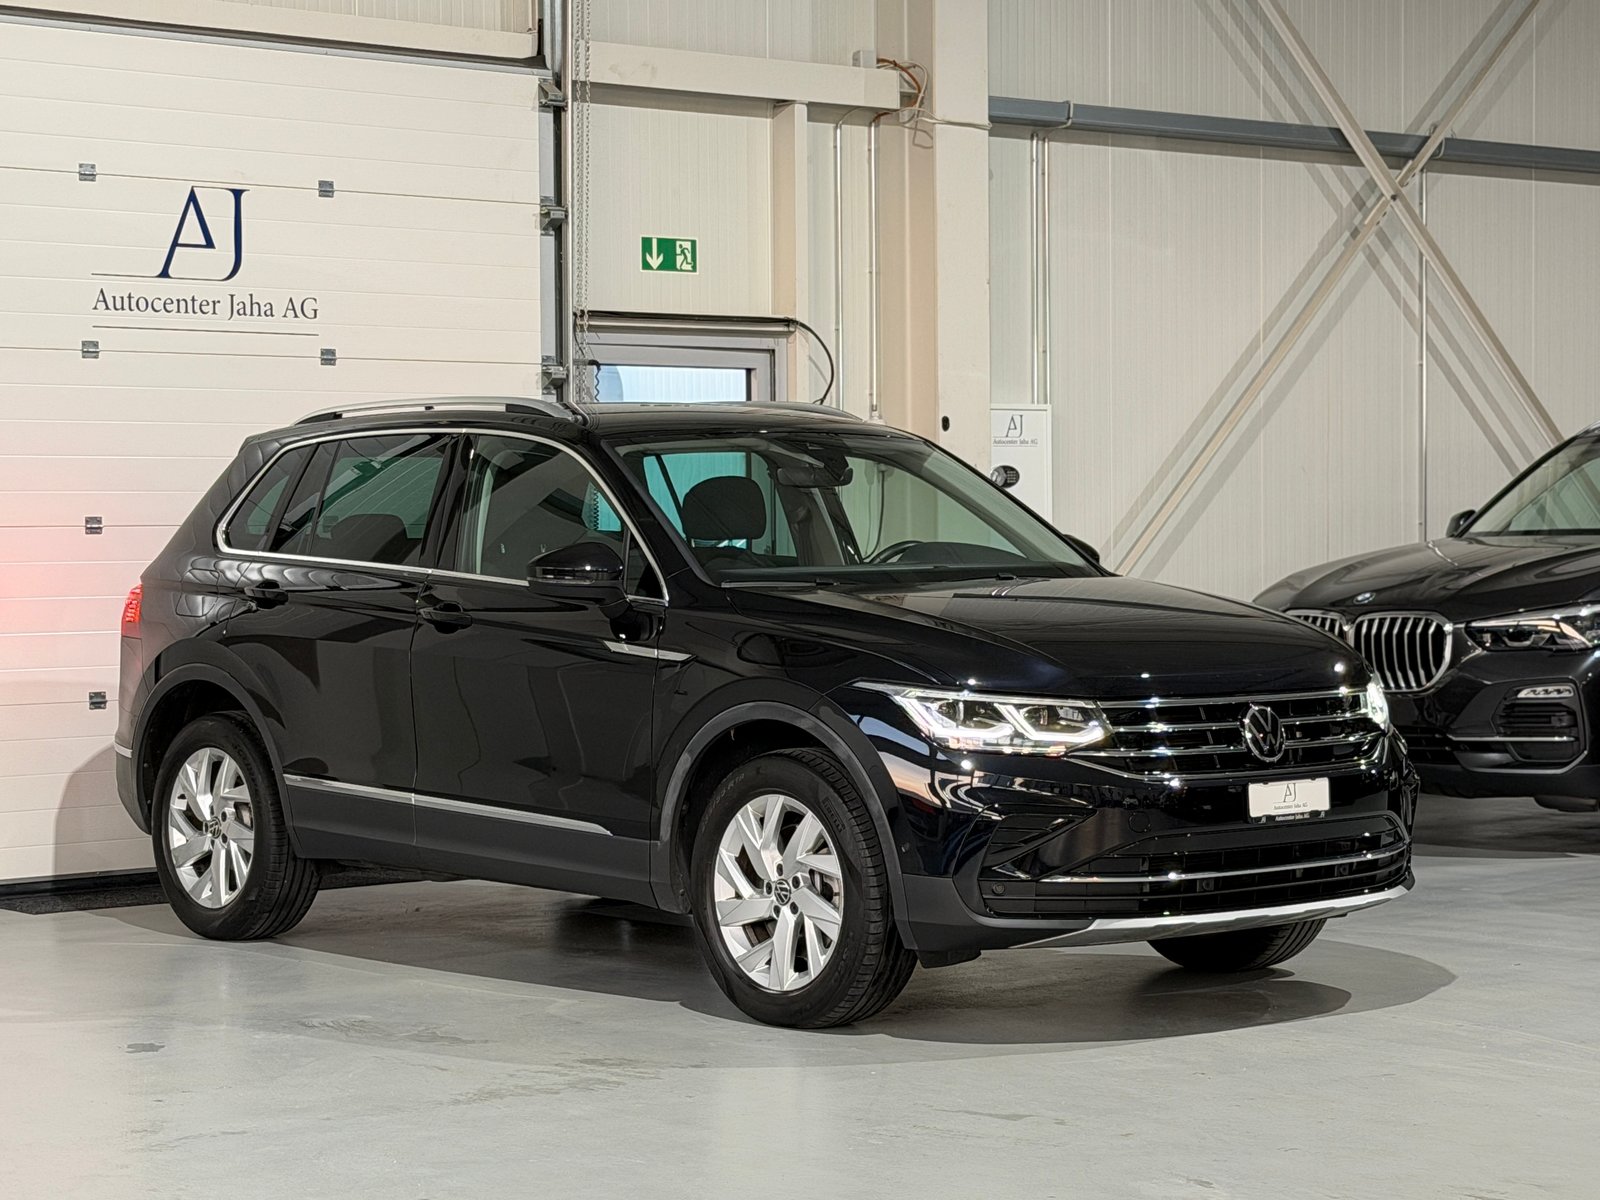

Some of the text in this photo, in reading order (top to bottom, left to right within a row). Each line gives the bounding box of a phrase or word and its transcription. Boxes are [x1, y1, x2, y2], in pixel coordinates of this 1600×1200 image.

[155, 185, 250, 282] AJ
[92, 288, 319, 321] Autocenter Jaha AG
[1005, 414, 1024, 438] AJ
[1283, 782, 1297, 803] AJ
